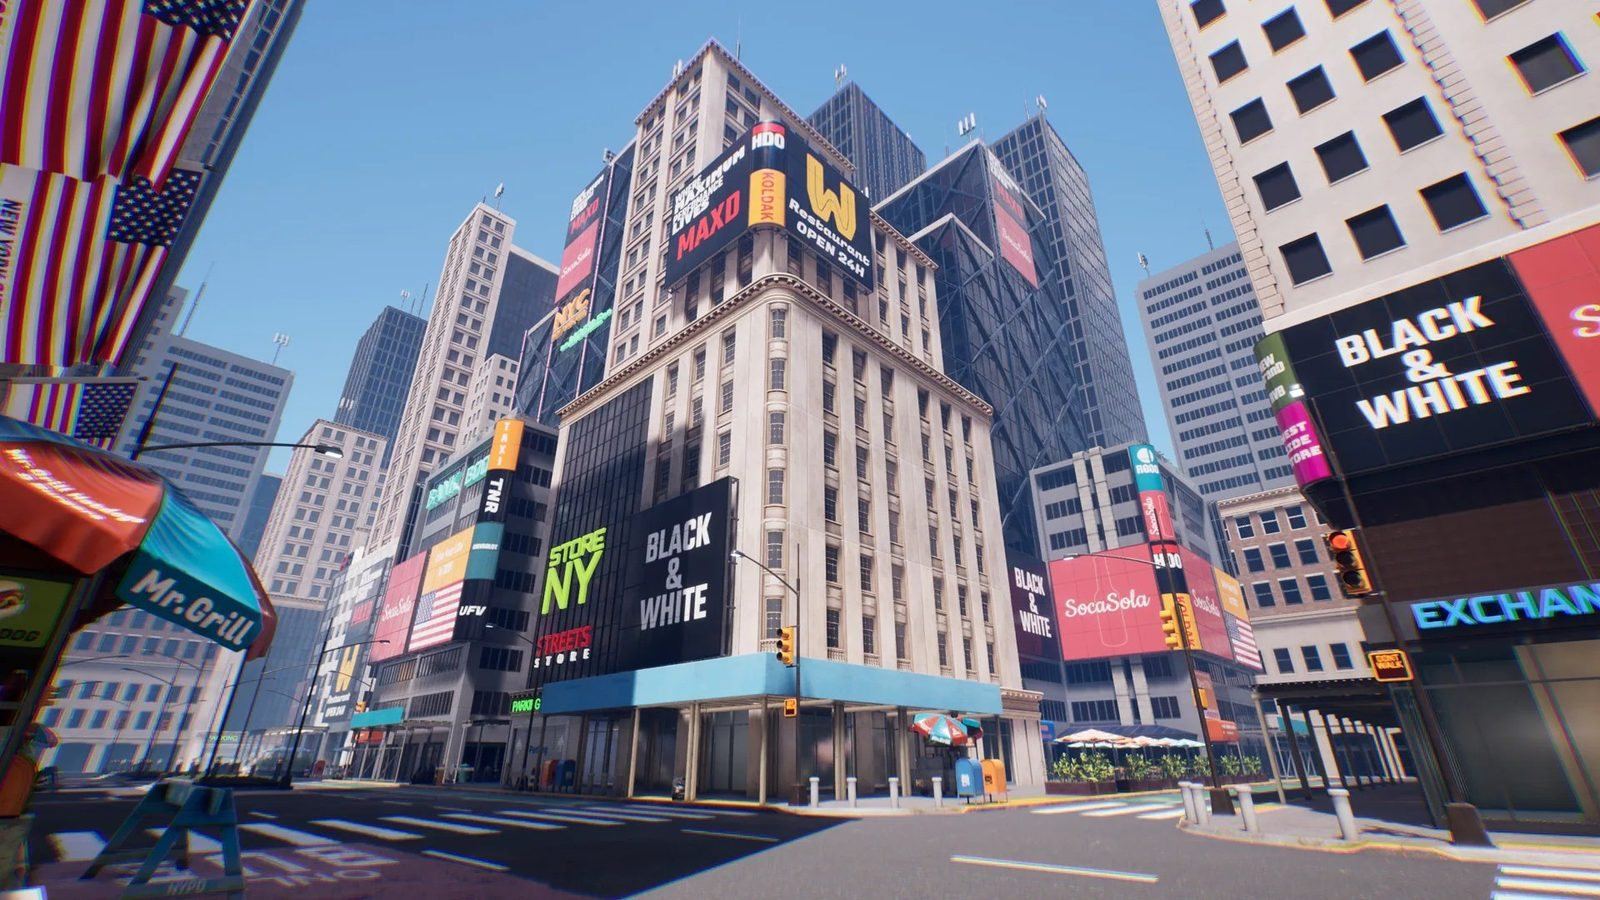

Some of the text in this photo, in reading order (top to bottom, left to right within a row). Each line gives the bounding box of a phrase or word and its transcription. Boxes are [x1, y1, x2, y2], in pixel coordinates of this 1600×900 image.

[752, 131, 785, 150] HDO
[761, 172, 774, 221] KOLDAK
[806, 152, 857, 242] W
[677, 190, 740, 260] MAXD
[788, 198, 870, 266] Restaurant
[796, 221, 865, 278] OPEN 24H
[1335, 296, 1496, 368] BLACK
[1400, 348, 1453, 383] &
[1355, 360, 1532, 430] WHITE
[497, 421, 510, 467] TAXI
[484, 478, 504, 513] TNR
[549, 527, 608, 567] STORE
[645, 512, 712, 563] BLACK
[541, 550, 603, 615] NY
[665, 557, 683, 590] &
[1013, 566, 1046, 597] BLACK
[129, 568, 255, 645] Mr.Grill
[459, 605, 487, 616] UFV
[640, 583, 709, 631] WHITE
[1019, 609, 1052, 638] WHITE
[1028, 592, 1039, 615] &
[1065, 588, 1150, 618] SocaSola
[533, 648, 591, 668] STORE
[537, 626, 593, 657] STREETS
